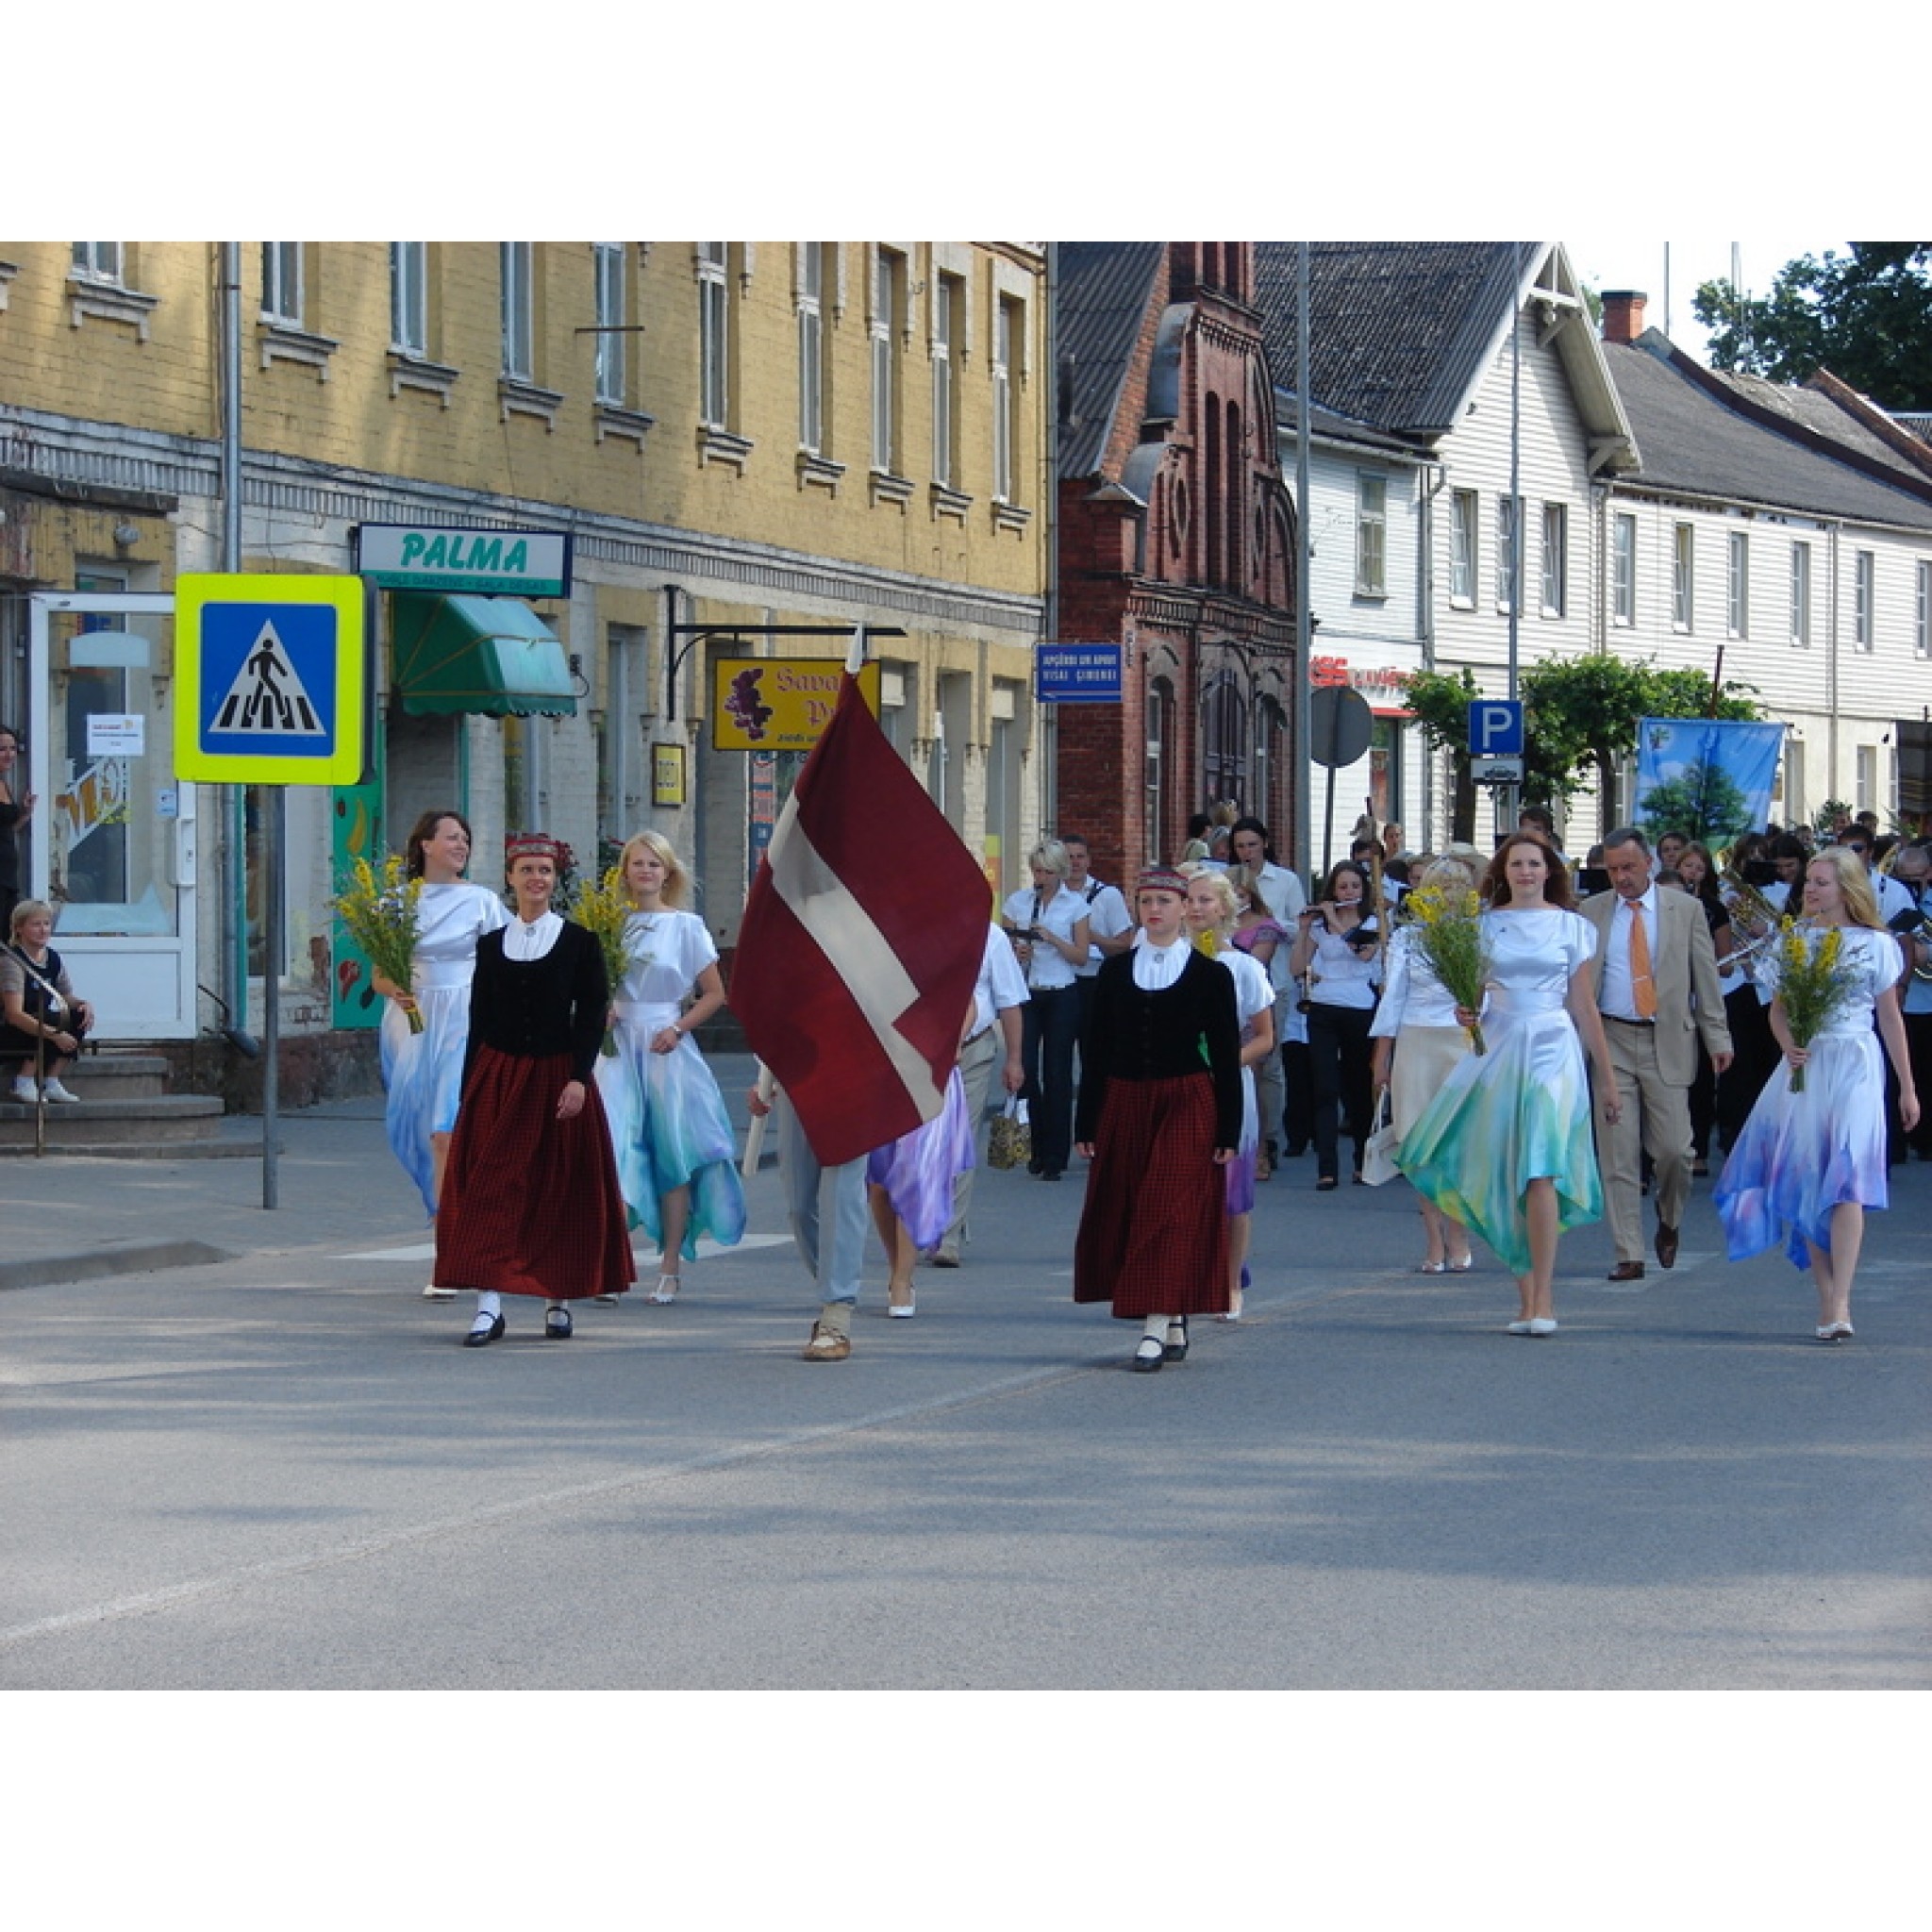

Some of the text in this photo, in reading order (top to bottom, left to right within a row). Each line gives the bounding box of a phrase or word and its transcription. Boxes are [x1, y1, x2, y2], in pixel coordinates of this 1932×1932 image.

[401, 533, 528, 574] PALMA
[776, 667, 841, 691] Sava
[1482, 707, 1513, 750] P
